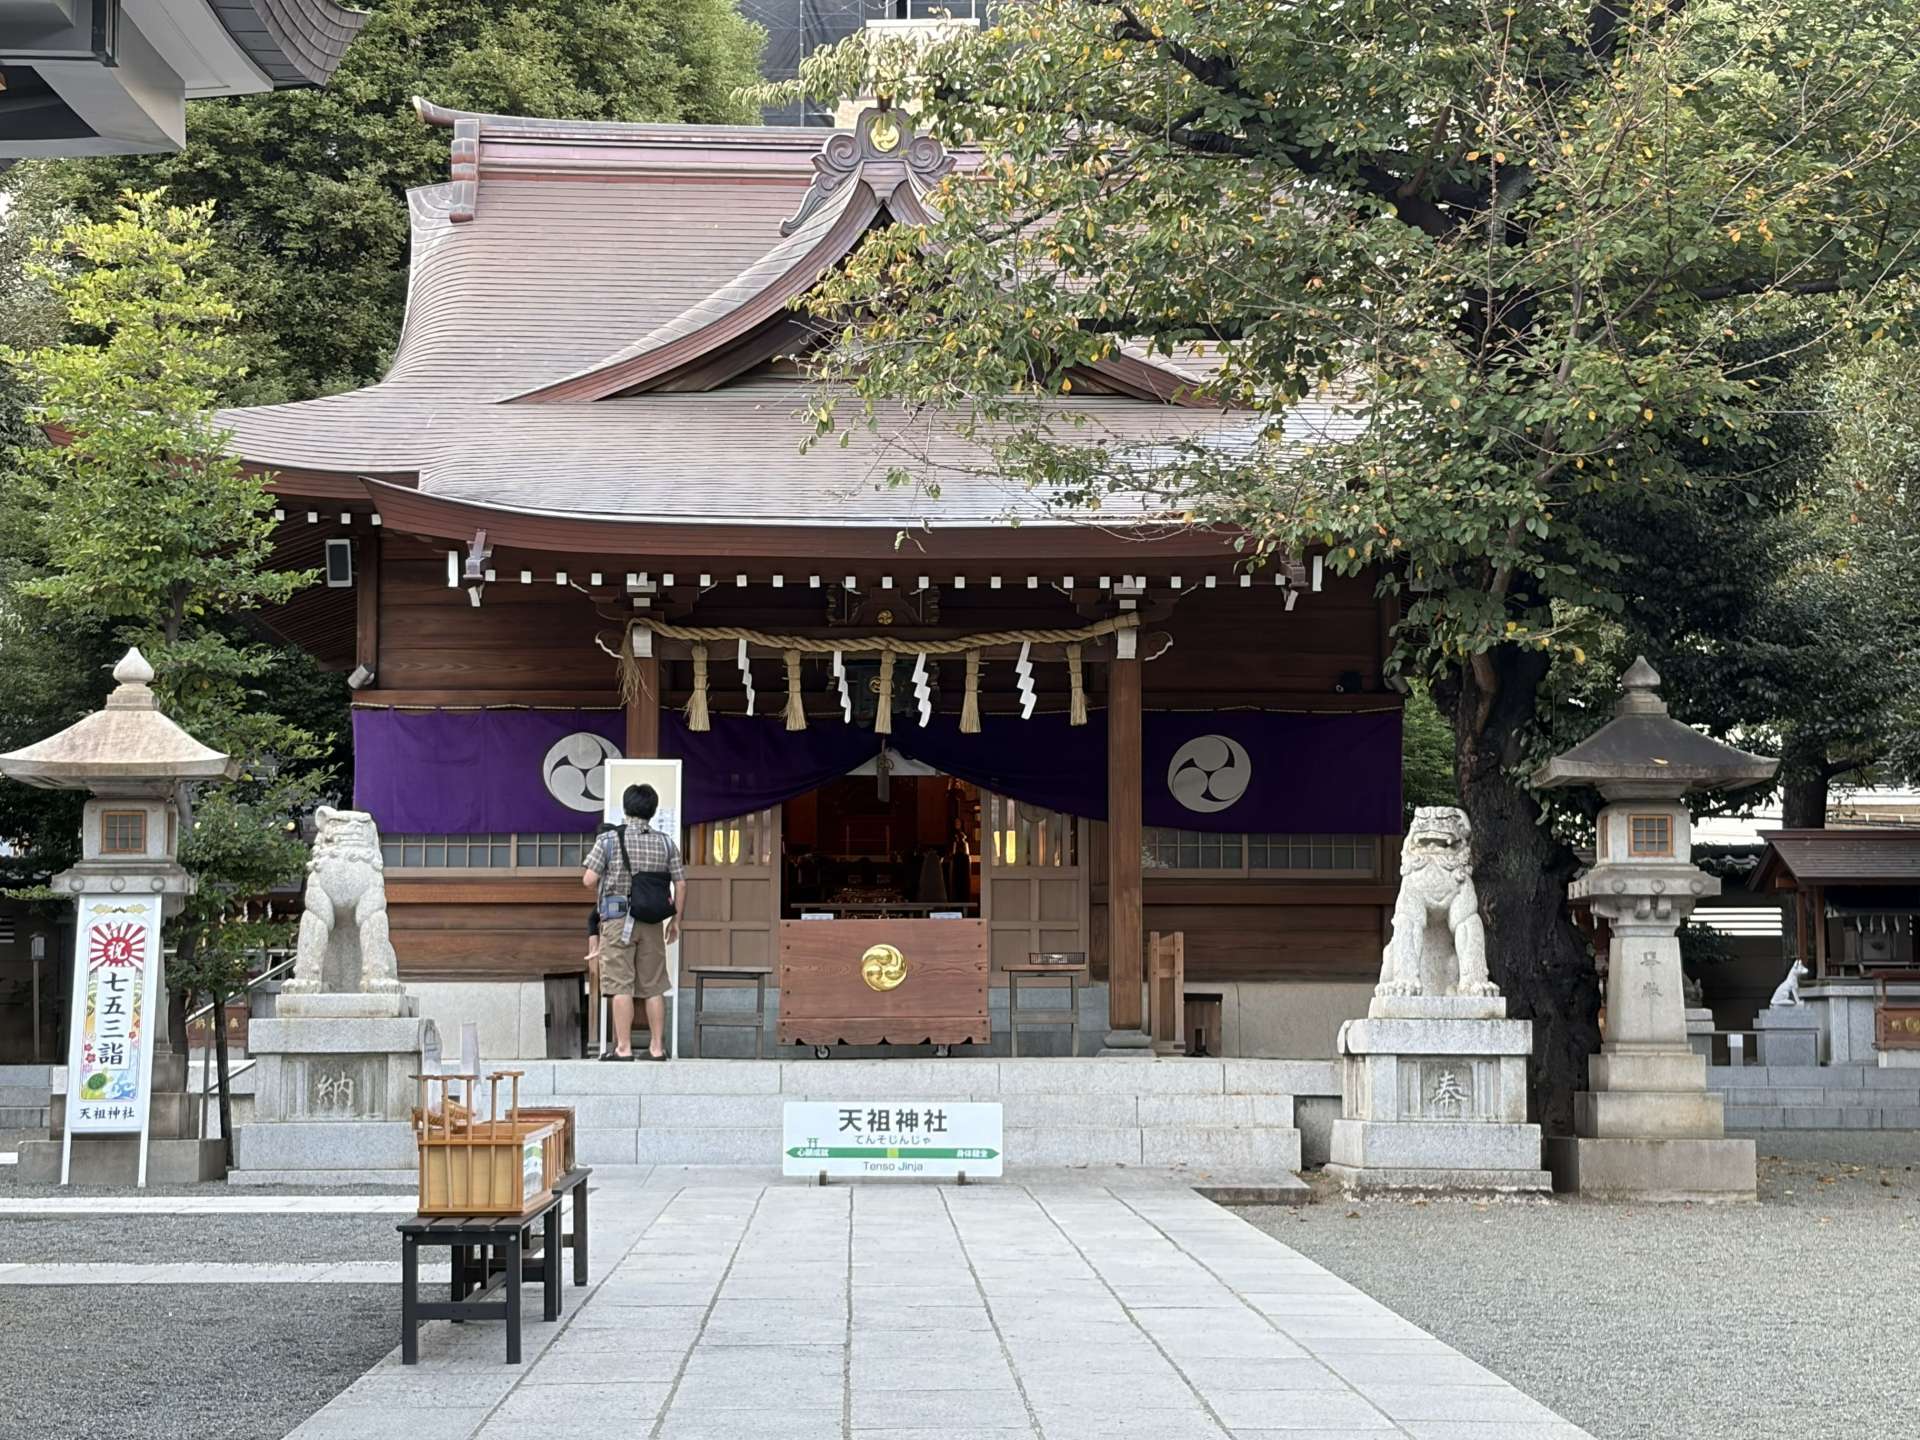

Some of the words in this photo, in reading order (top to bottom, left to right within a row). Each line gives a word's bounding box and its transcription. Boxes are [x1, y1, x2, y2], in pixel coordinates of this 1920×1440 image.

[107, 940, 129, 960] 祝
[98, 971, 129, 1065] 七五三詣
[317, 1071, 354, 1107] 納
[1432, 1070, 1467, 1114] 奉
[80, 1106, 135, 1120] 天祖神社
[838, 1108, 948, 1133] 天祖神社
[855, 1134, 932, 1146] てんそじんじゃ
[863, 1161, 895, 1171] Tenso
[898, 1161, 924, 1172] Jinja
